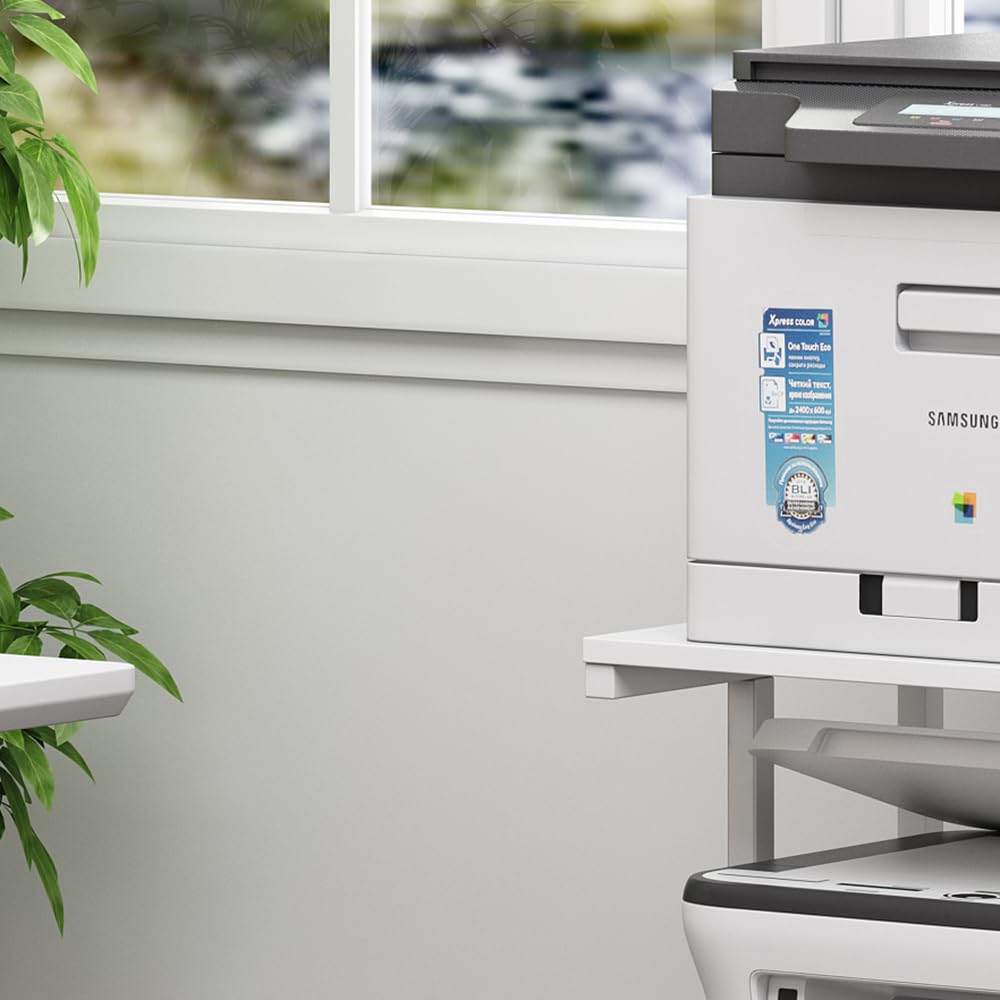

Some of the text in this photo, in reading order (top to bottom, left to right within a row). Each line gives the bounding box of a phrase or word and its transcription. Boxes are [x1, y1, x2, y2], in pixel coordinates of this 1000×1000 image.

[768, 314, 793, 327] Xpress
[788, 342, 831, 352] One Touch Eco
[928, 411, 999, 429] SAMSUNG
[791, 484, 811, 494] BLI
